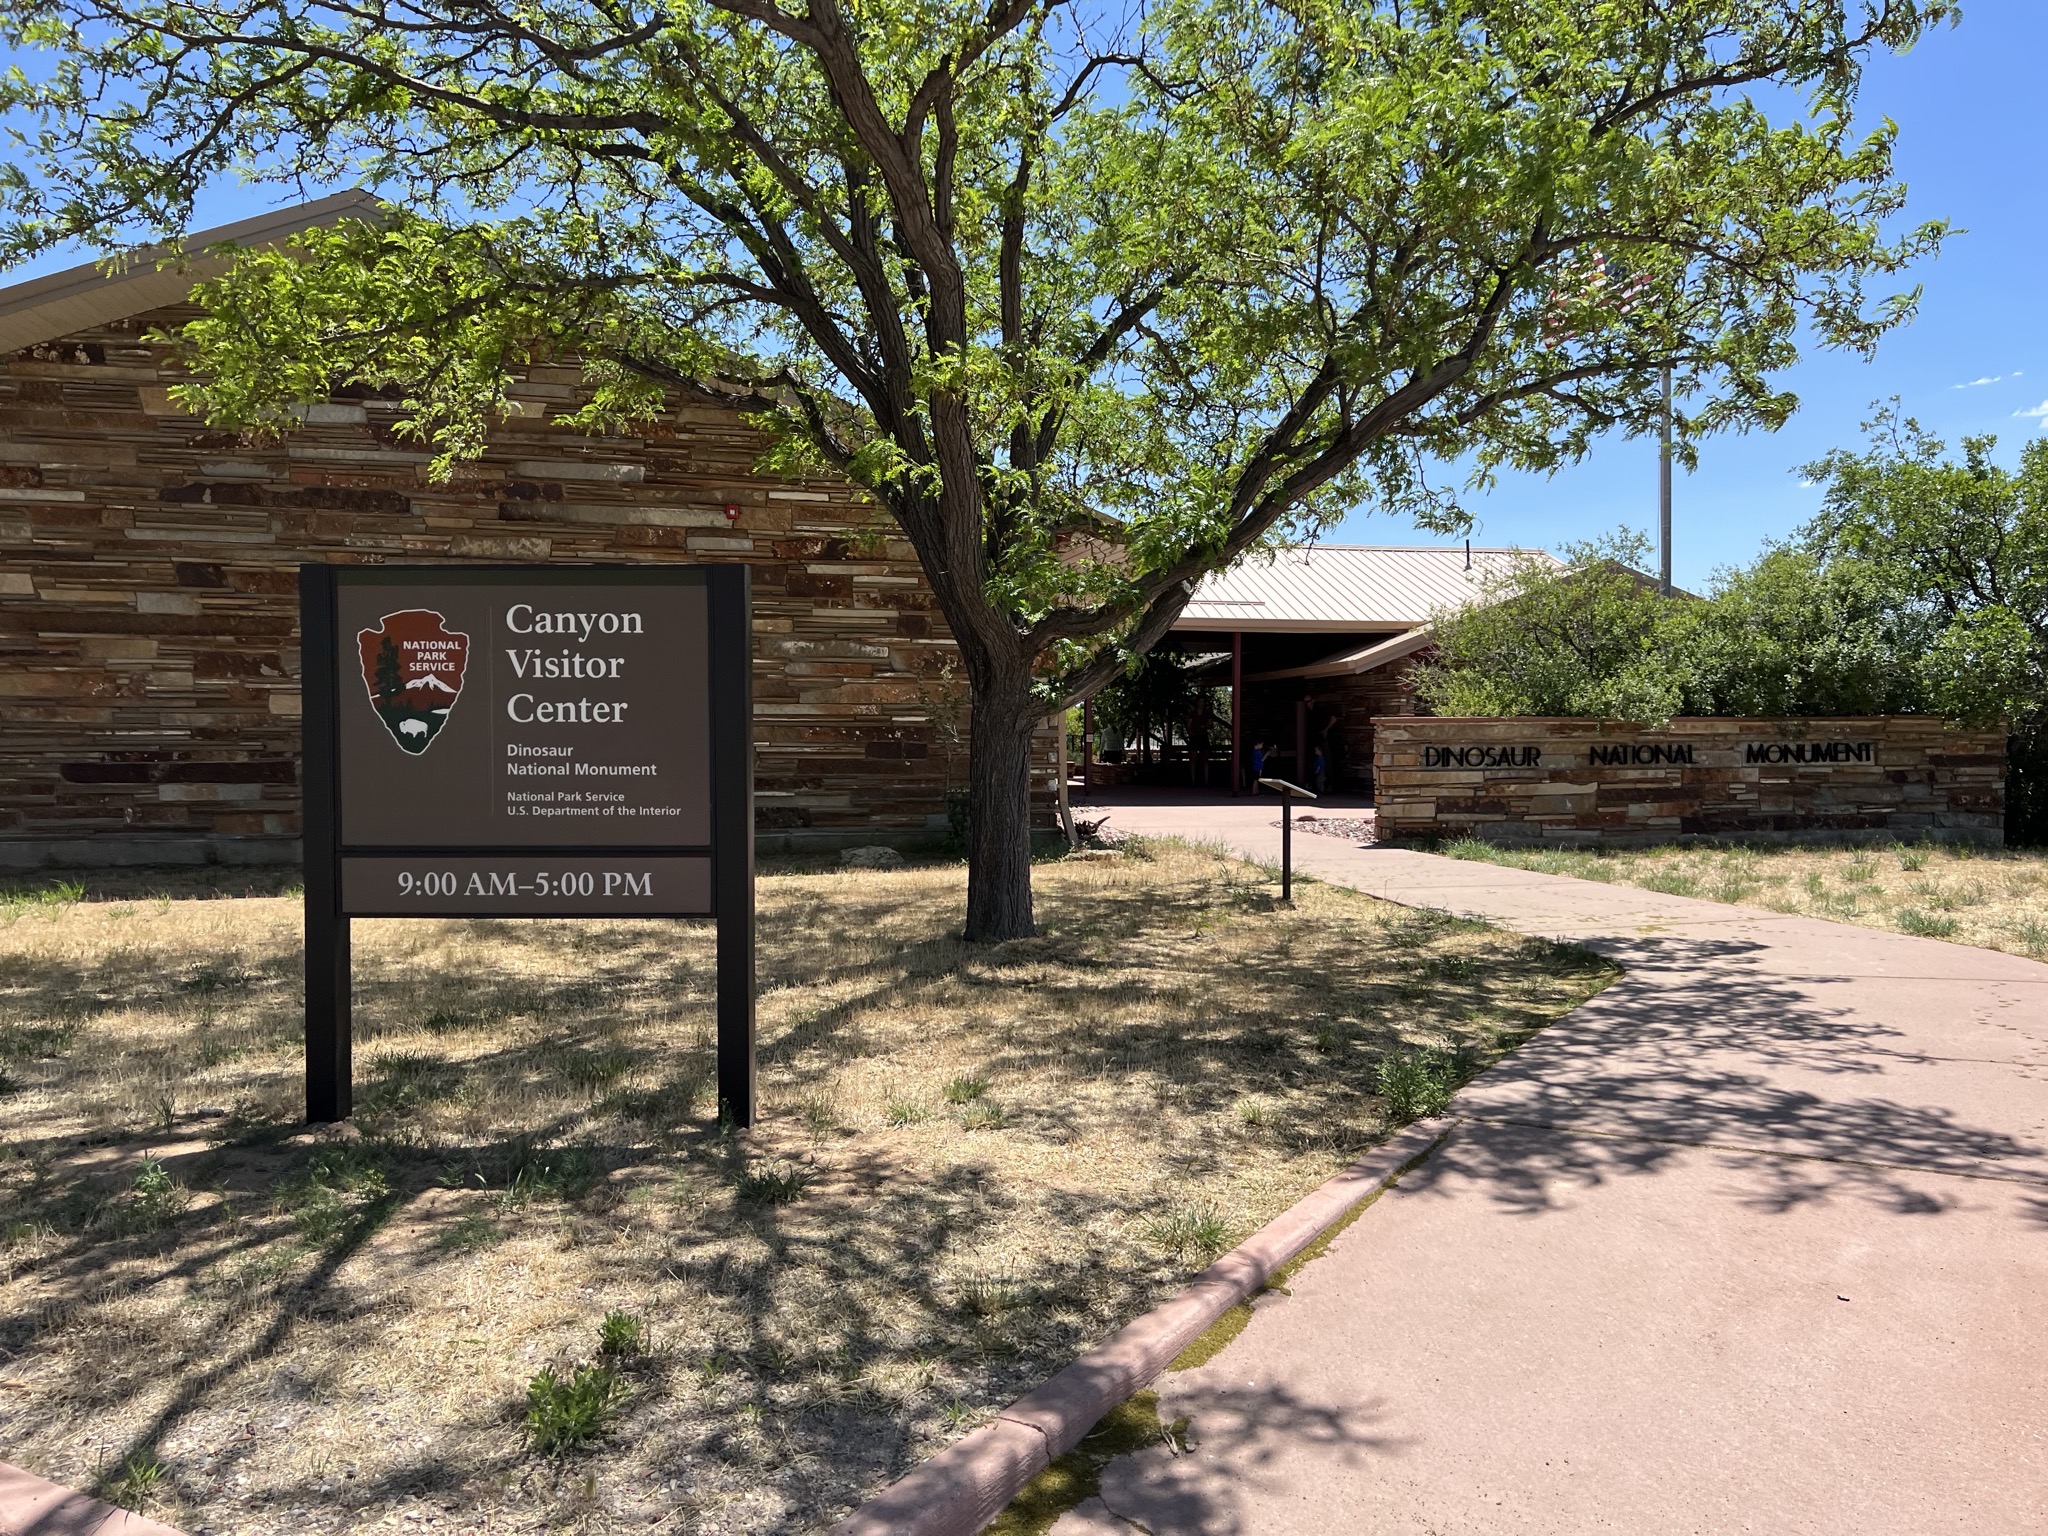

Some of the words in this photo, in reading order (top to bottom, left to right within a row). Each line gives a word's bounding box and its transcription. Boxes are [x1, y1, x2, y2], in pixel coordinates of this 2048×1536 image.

[506, 604, 644, 643] Canyon
[403, 640, 462, 650] NATIONAL
[417, 651, 447, 661] PARK
[409, 662, 456, 672] SERVICE
[505, 648, 625, 679] Visitor
[507, 693, 629, 723] Center
[507, 743, 574, 757] Dinosaur
[1424, 746, 1541, 767] DINOSAUR
[1590, 744, 1698, 766] NATIONAL
[1746, 742, 1871, 764] MONUMENT
[507, 762, 570, 776] National
[574, 763, 657, 776] Monument
[507, 791, 555, 802] National
[557, 791, 582, 802] Park
[585, 791, 625, 802] Service
[507, 805, 529, 816] U.S.
[532, 806, 600, 818] Department
[602, 805, 615, 816] of
[617, 805, 637, 816] the
[639, 805, 682, 816] Interior
[397, 871, 457, 896] 9:00
[602, 872, 654, 896] PM
